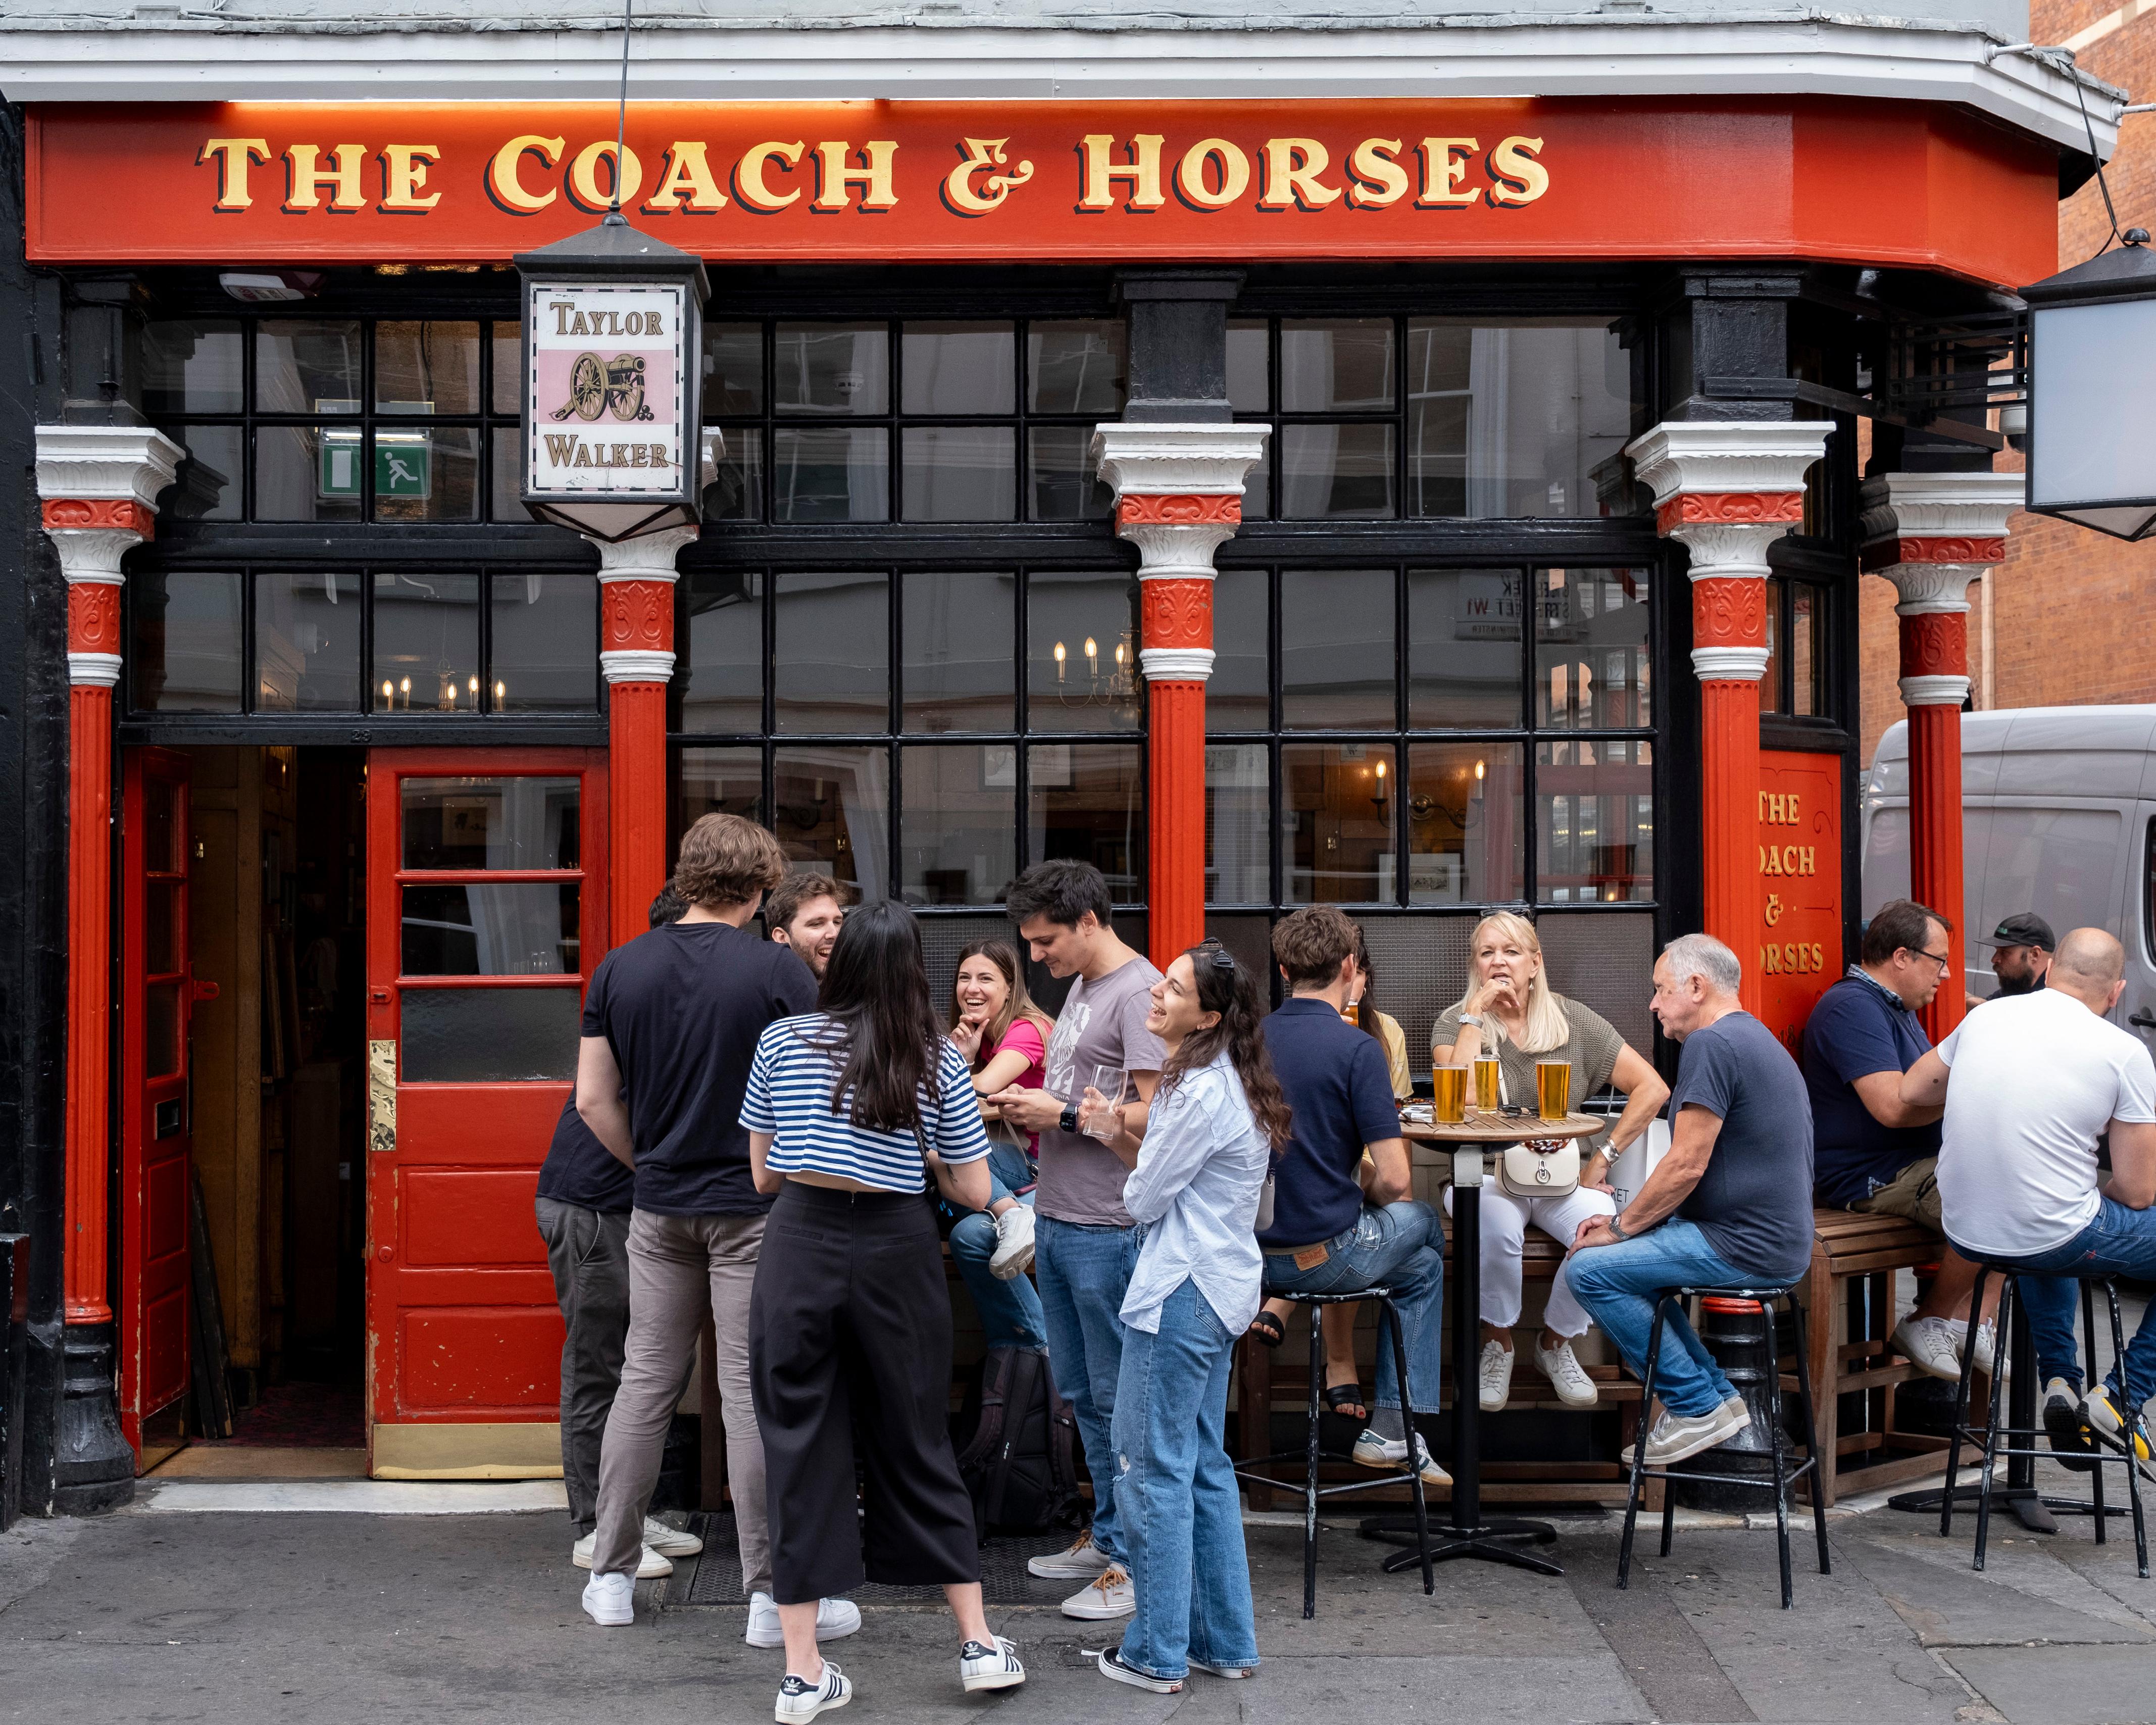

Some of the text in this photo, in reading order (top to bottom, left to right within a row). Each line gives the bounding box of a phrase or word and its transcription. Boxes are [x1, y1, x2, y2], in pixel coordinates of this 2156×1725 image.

[195, 134, 1549, 219] THE COACH & HORSES
[550, 302, 664, 335] TAYLOR
[544, 434, 669, 468] WALKER
[1759, 845, 1815, 877] ACH
[1764, 894, 1783, 927] &
[1760, 943, 1823, 975] RSES
